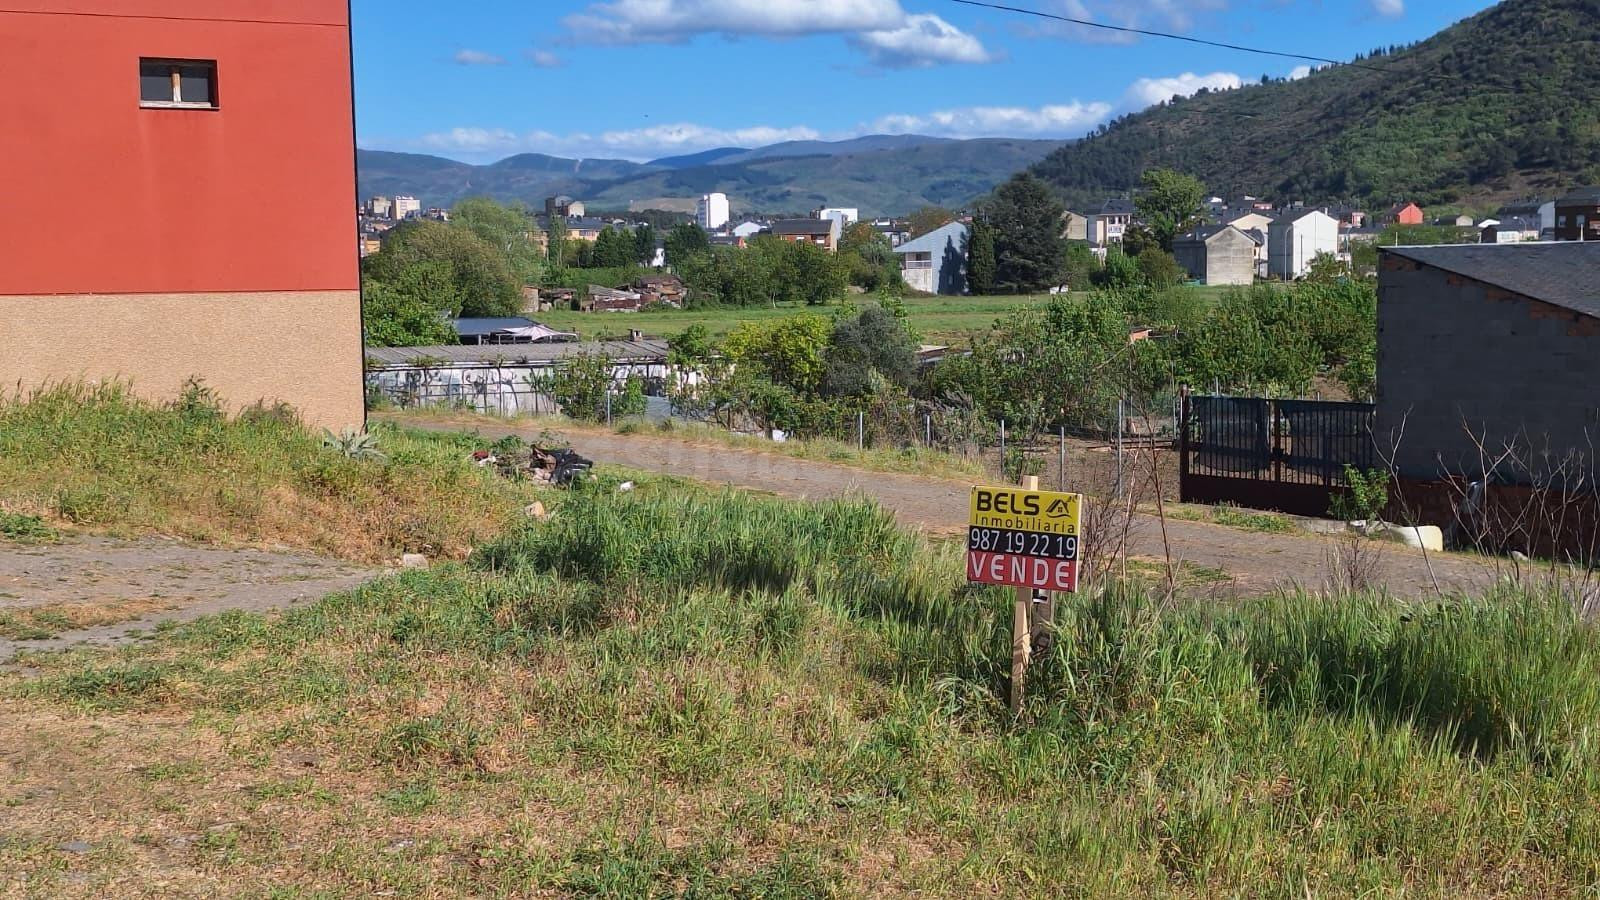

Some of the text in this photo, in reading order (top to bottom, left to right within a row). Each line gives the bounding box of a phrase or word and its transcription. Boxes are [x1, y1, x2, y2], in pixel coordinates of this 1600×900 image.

[976, 491, 1040, 516] BELS
[975, 513, 1075, 534] Inmobiliaria
[971, 528, 1076, 559] 987 19 22 19
[970, 551, 1070, 588] VENDE
